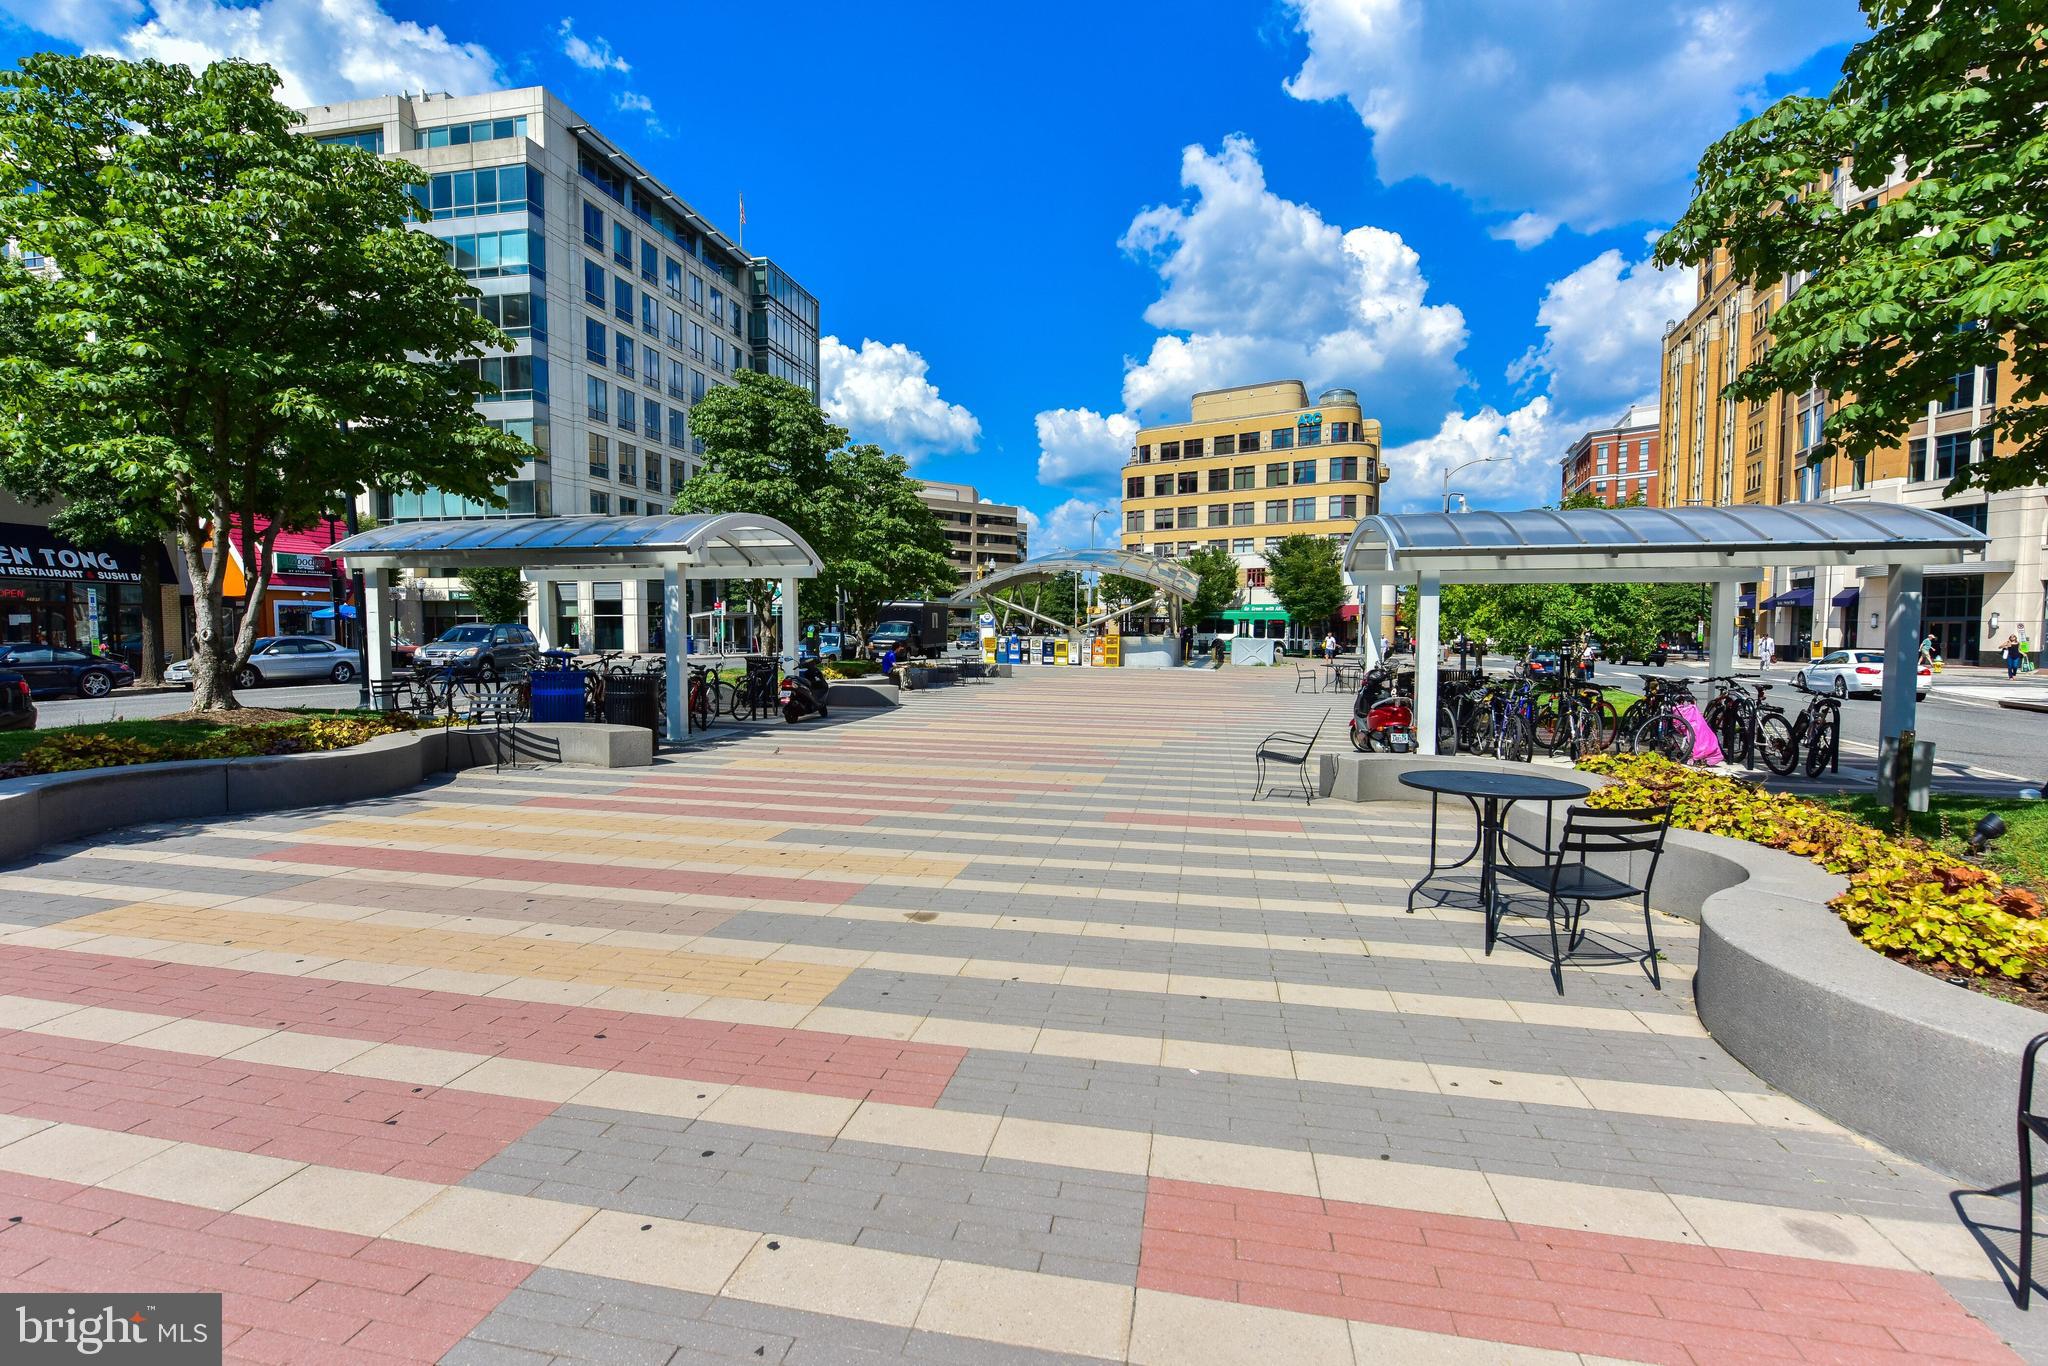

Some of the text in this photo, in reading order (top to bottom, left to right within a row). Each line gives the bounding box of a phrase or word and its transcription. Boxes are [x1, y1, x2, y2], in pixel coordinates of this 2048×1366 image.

[1297, 411, 1323, 427] ARC
[38, 548, 119, 571] TONG
[8, 566, 83, 579] RESTAURANT
[97, 571, 130, 581] SUSHI
